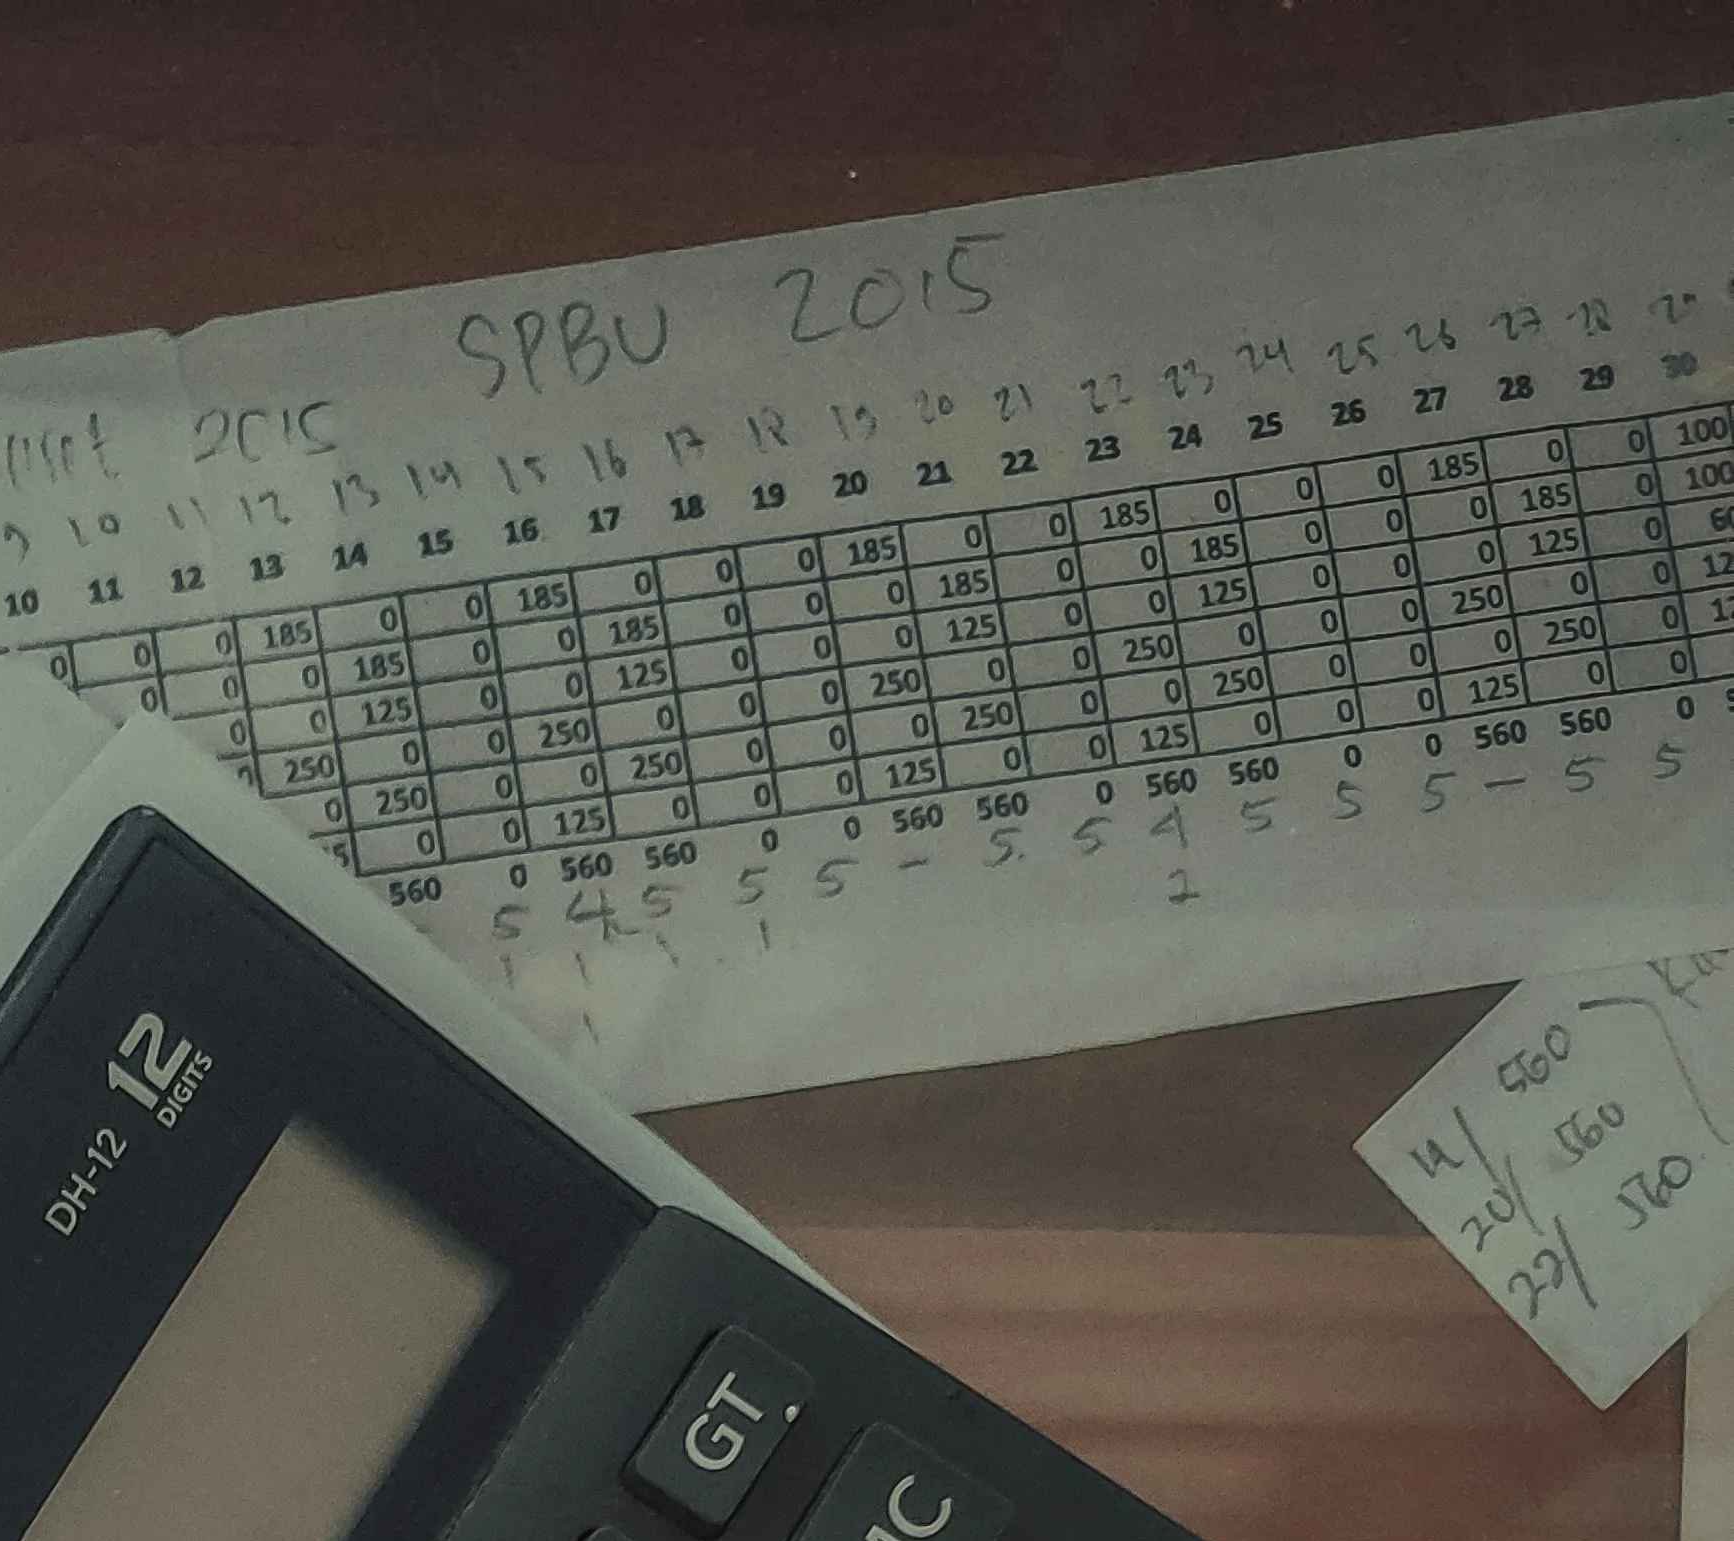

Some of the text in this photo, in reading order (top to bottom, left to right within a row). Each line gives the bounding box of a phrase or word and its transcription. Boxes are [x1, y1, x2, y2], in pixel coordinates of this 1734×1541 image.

[455, 232, 1010, 400] SPBU 2015
[4, 588, 39, 617] 10
[88, 573, 124, 605] 11
[171, 564, 205, 593] 12
[249, 552, 286, 582] 13
[332, 541, 369, 571] 14
[418, 528, 454, 559] 15
[502, 515, 540, 546] 16
[588, 505, 622, 533] 17
[669, 493, 706, 522] 18
[752, 482, 787, 510] 19
[832, 469, 868, 498] 20
[916, 460, 954, 487] 21
[1000, 449, 1039, 476] 22
[1085, 435, 1121, 463] 23
[1167, 423, 1203, 450] 24
[1247, 412, 1283, 440] 25
[1331, 398, 1366, 426] 26
[1413, 386, 1447, 415] 27
[1497, 374, 1534, 401] 28
[1579, 364, 1614, 391] 29
[108, 1012, 193, 1111] 12
[156, 1049, 214, 1129] DIGITS
[1497, 1023, 1572, 1093] 560
[43, 1128, 128, 1237] DH-12
[685, 1371, 764, 1471] GT
